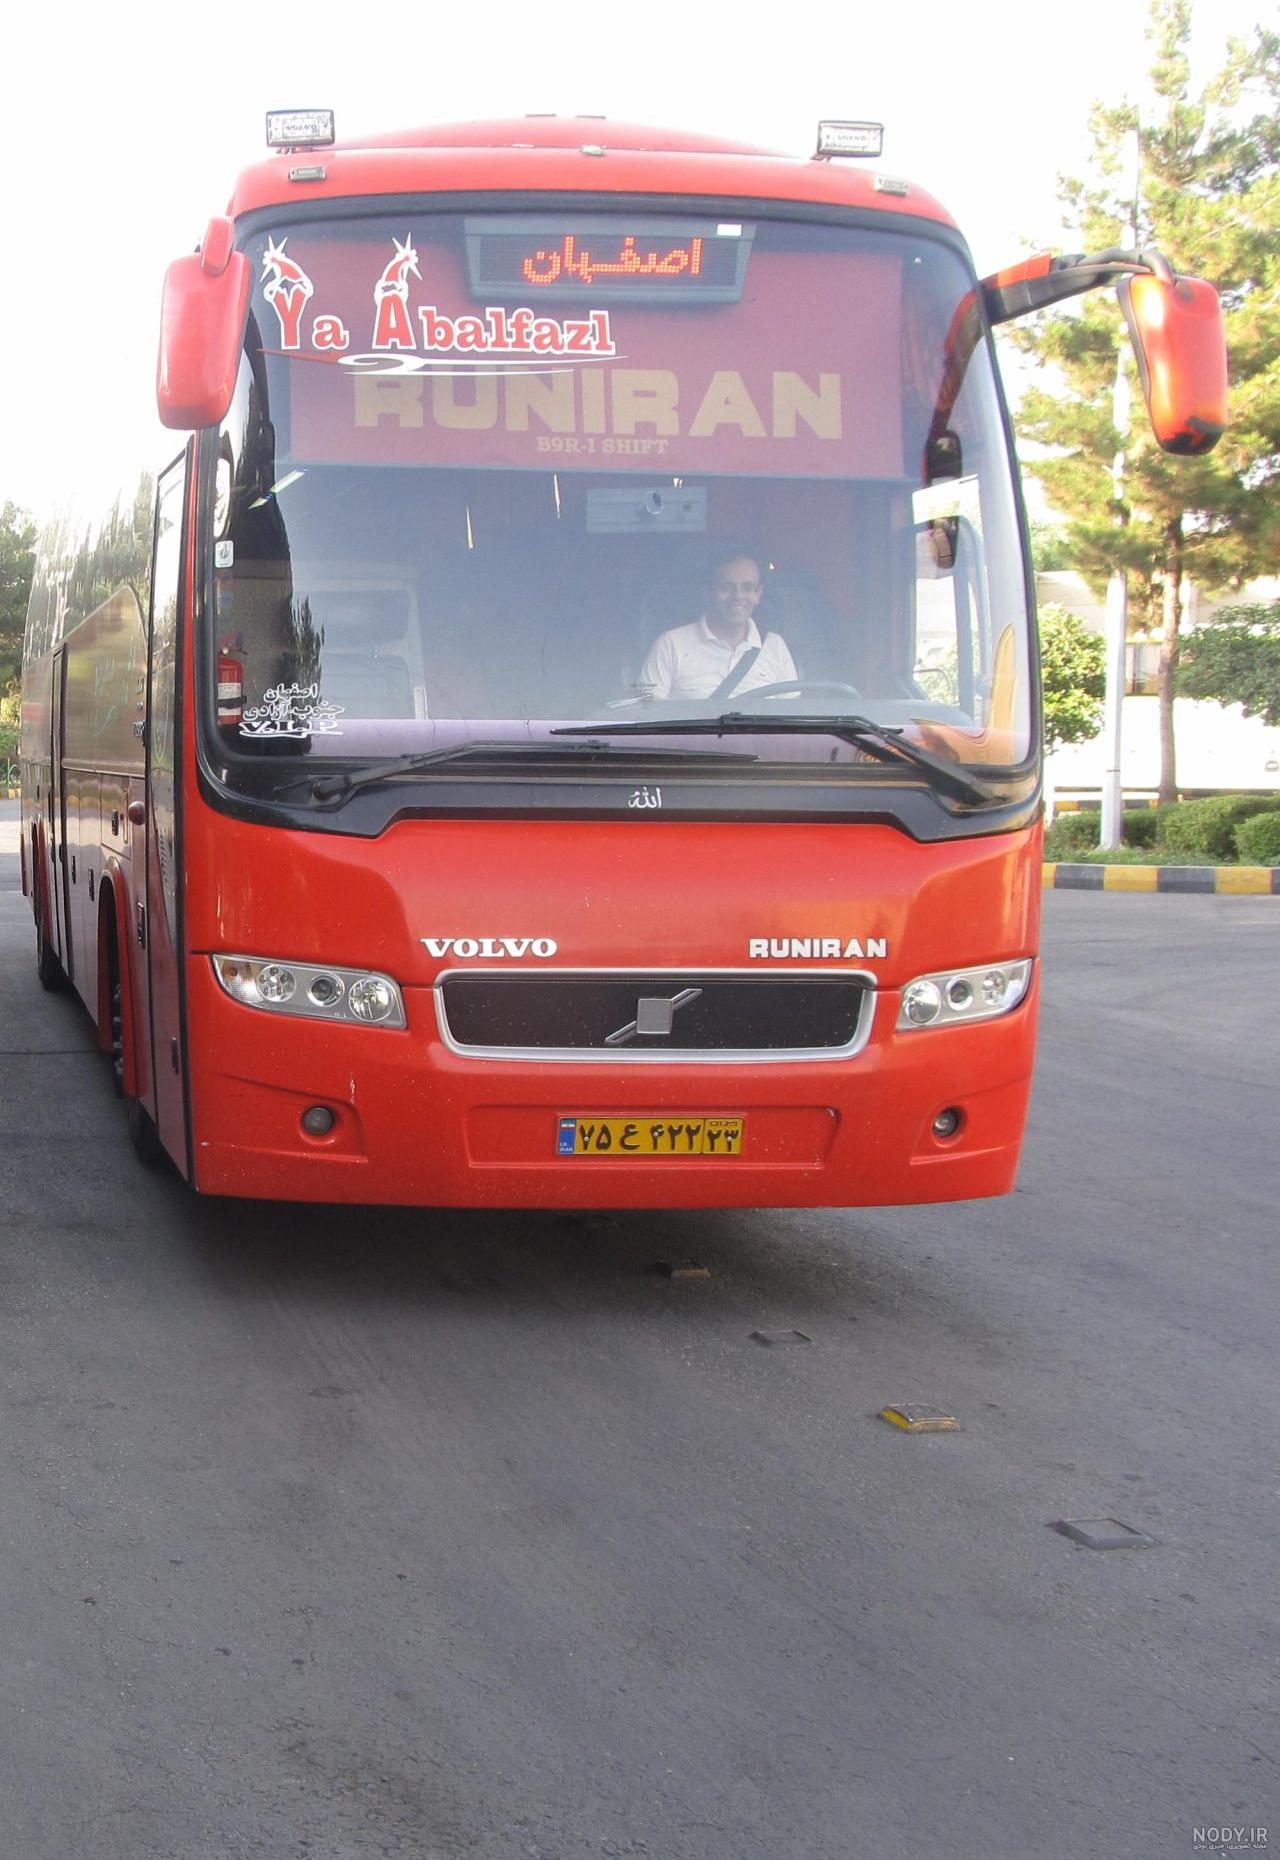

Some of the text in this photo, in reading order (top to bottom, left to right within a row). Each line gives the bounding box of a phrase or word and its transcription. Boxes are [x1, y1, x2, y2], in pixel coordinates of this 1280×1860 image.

[523, 235, 702, 284] اصفهان
[264, 278, 616, 356] Ya Abalfazl
[353, 366, 842, 440] RUNIRAN
[601, 438, 669, 456] SHIFT
[264, 683, 319, 703] اصفهان
[420, 937, 558, 958] VOLVO
[748, 937, 887, 959] RUNIRAN
